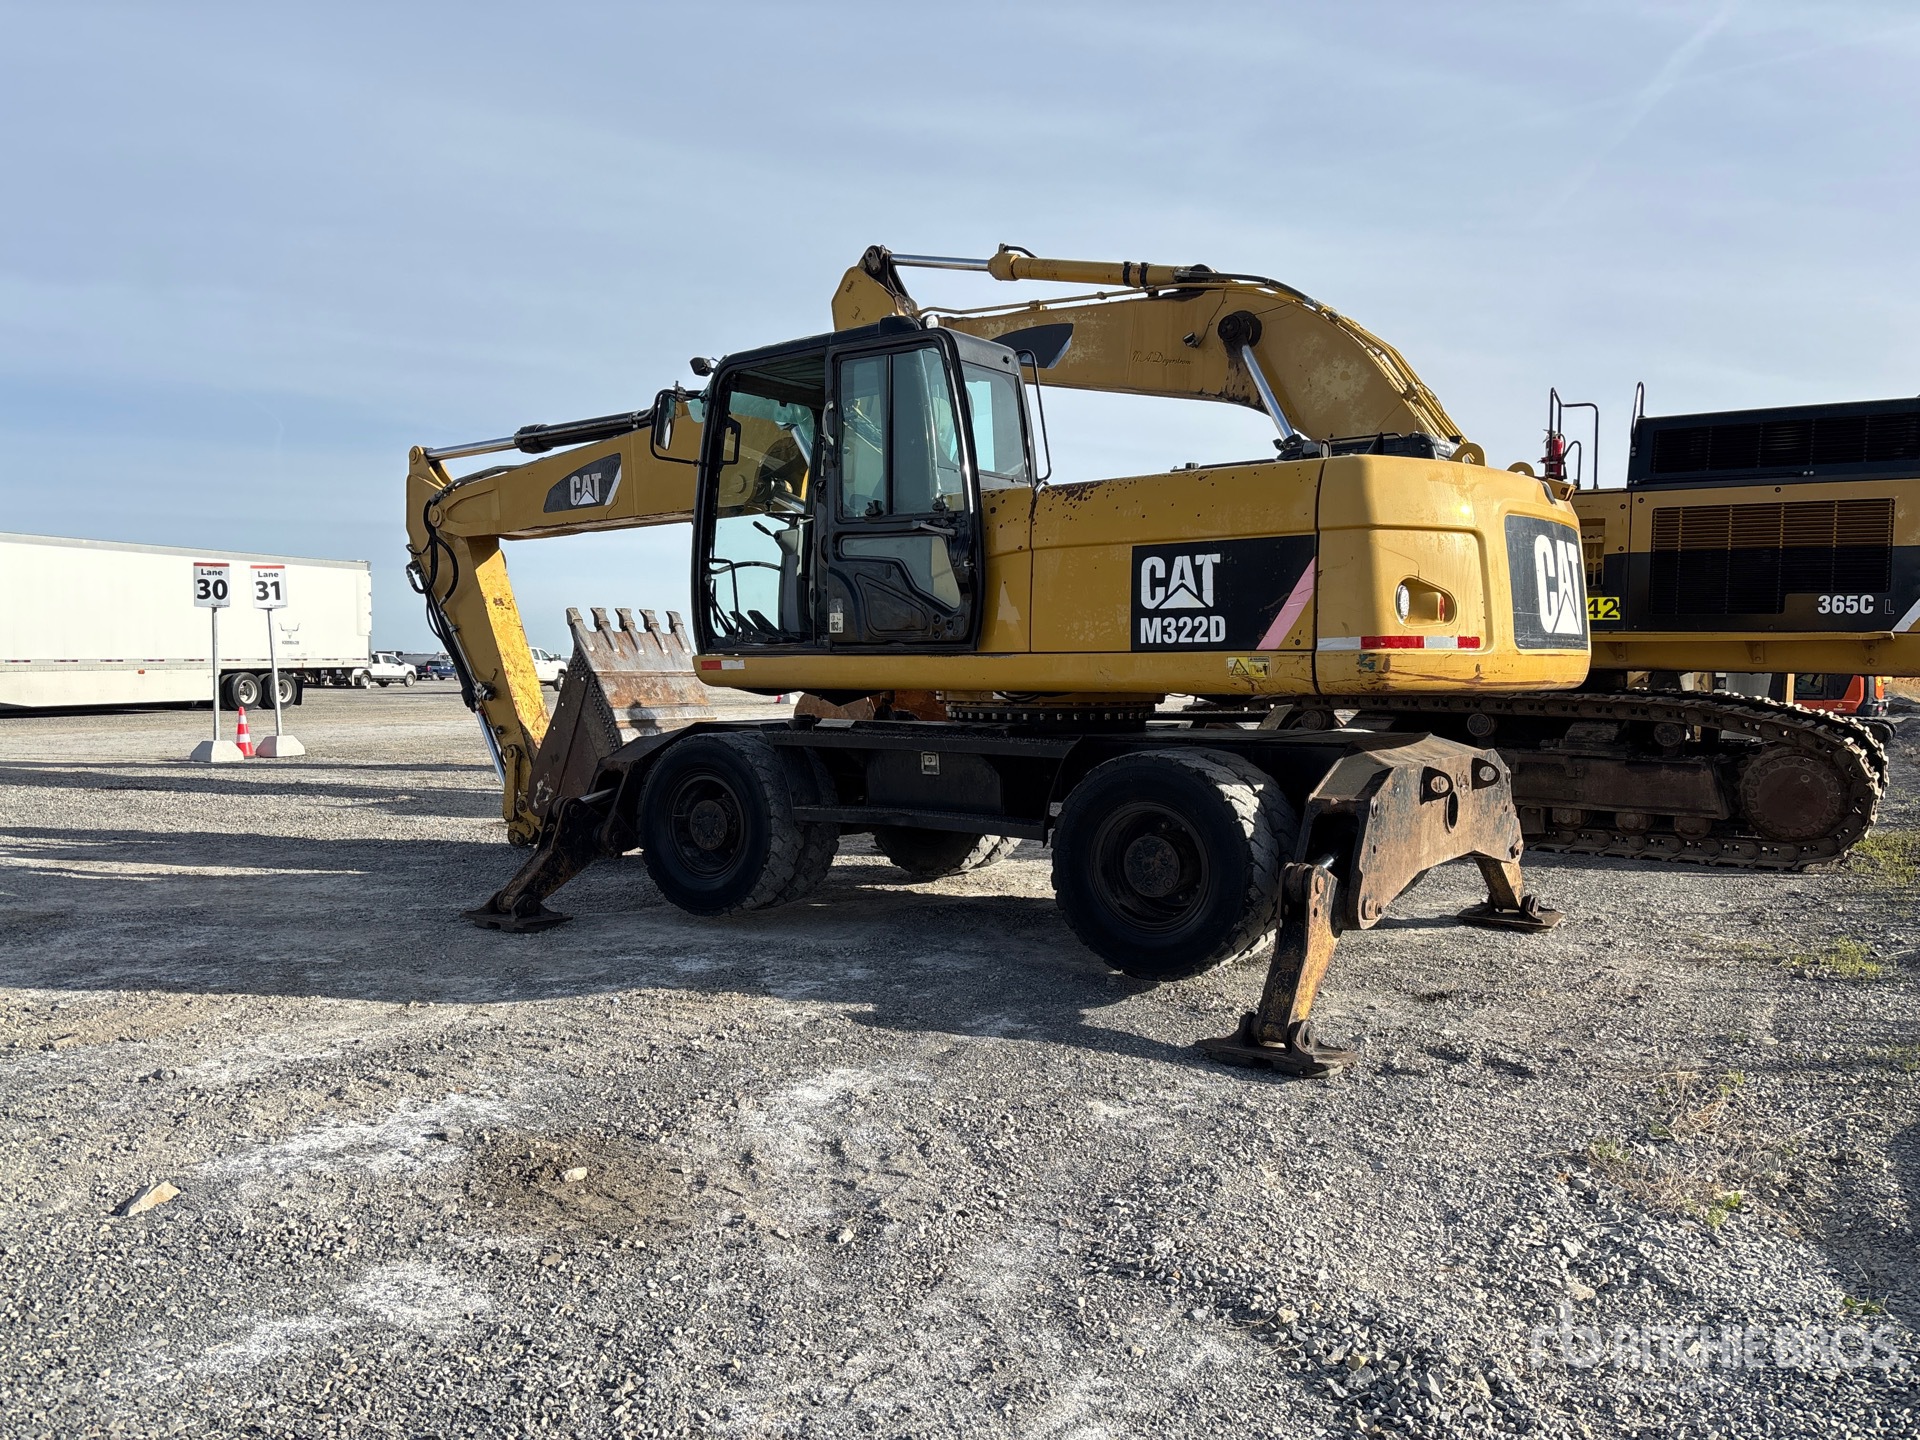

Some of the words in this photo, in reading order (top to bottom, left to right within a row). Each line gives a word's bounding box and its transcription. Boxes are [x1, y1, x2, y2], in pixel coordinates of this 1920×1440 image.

[569, 472, 602, 506] CAT
[200, 568, 223, 576] Lane
[1141, 553, 1221, 609] CAT
[1534, 534, 1582, 635] CAT
[196, 578, 228, 600] 30
[255, 580, 281, 601] 31
[1817, 594, 1874, 614] 365C
[1884, 599, 1895, 615] L
[1140, 615, 1226, 643] M322D
